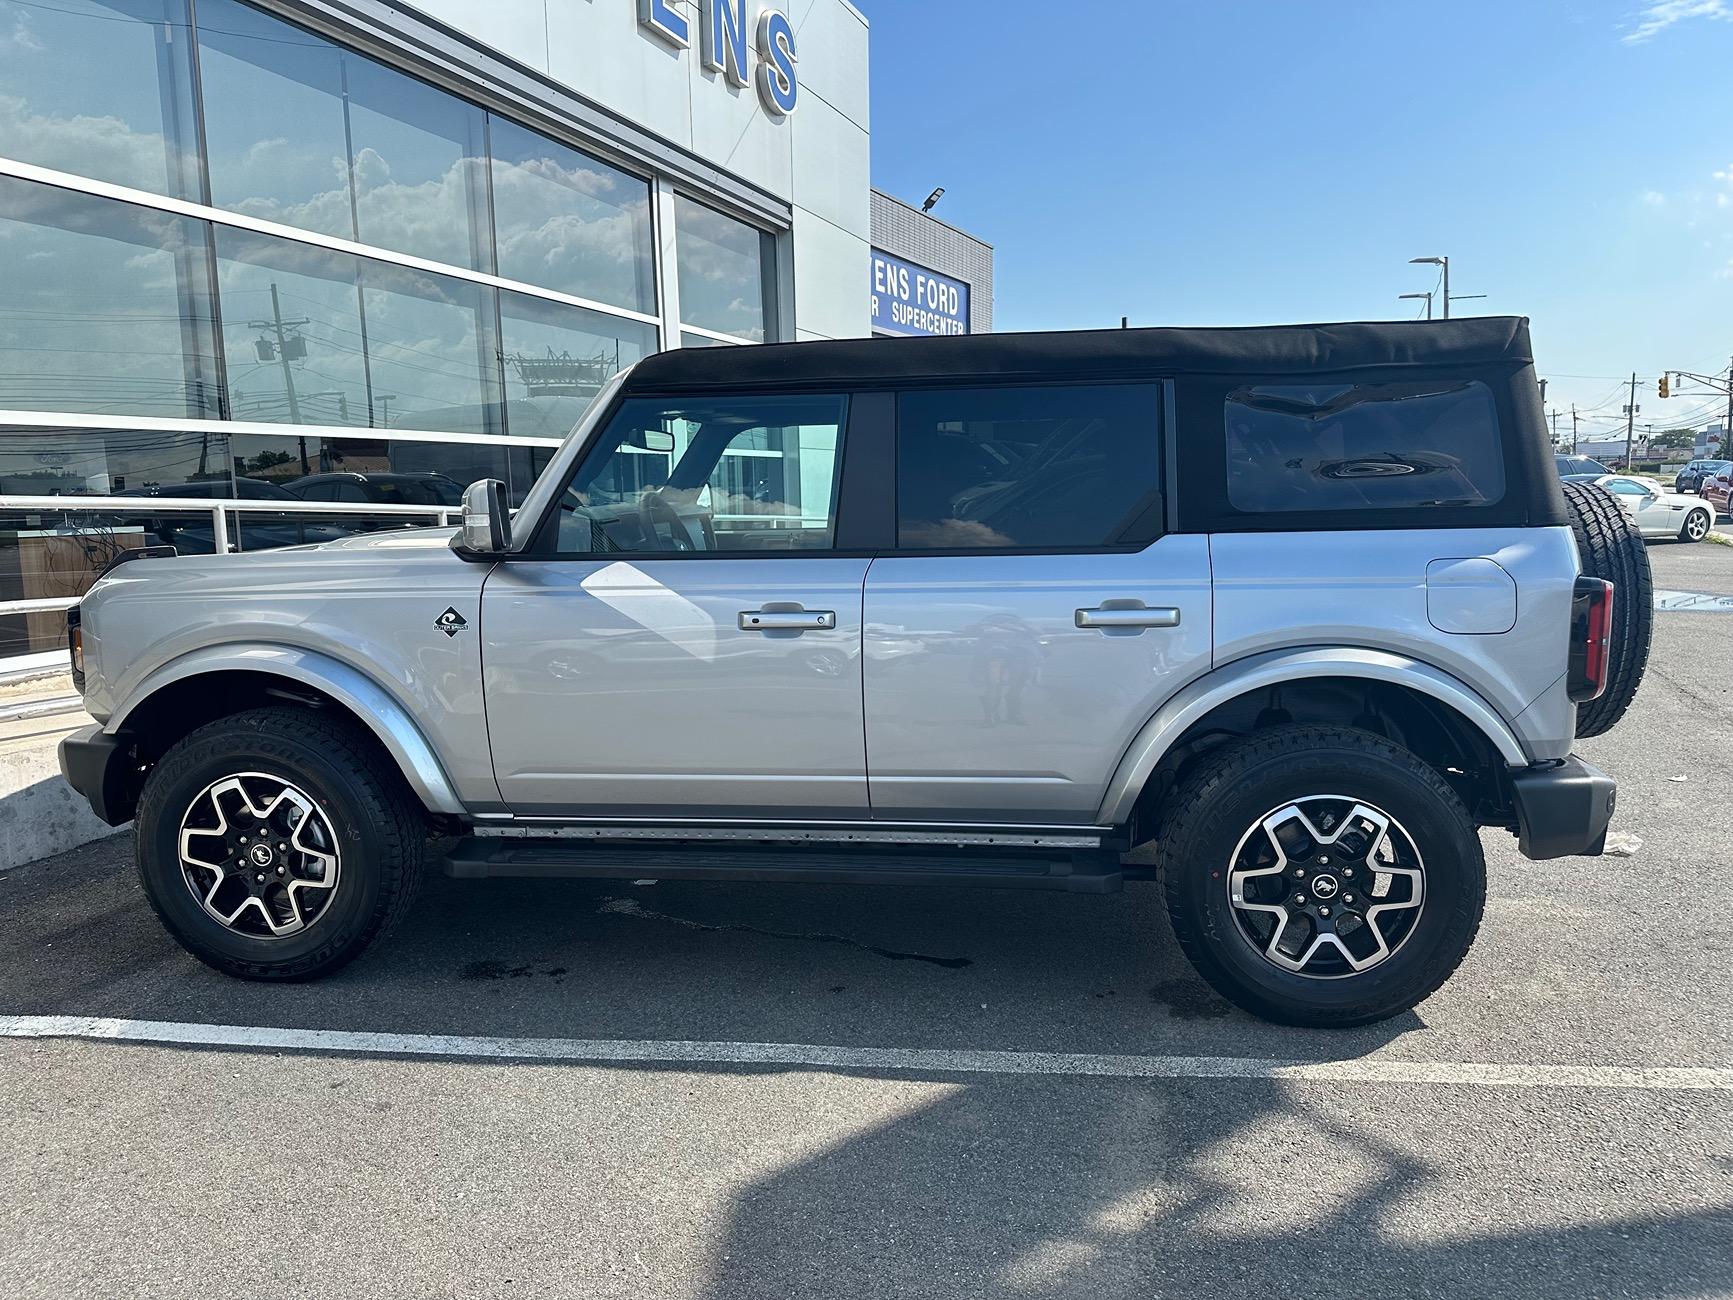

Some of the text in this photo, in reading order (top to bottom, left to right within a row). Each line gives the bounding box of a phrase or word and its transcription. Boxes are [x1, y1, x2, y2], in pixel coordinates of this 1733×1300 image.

[870, 257, 958, 316] ENS FORD
[892, 301, 964, 335] SUPERCENTER
